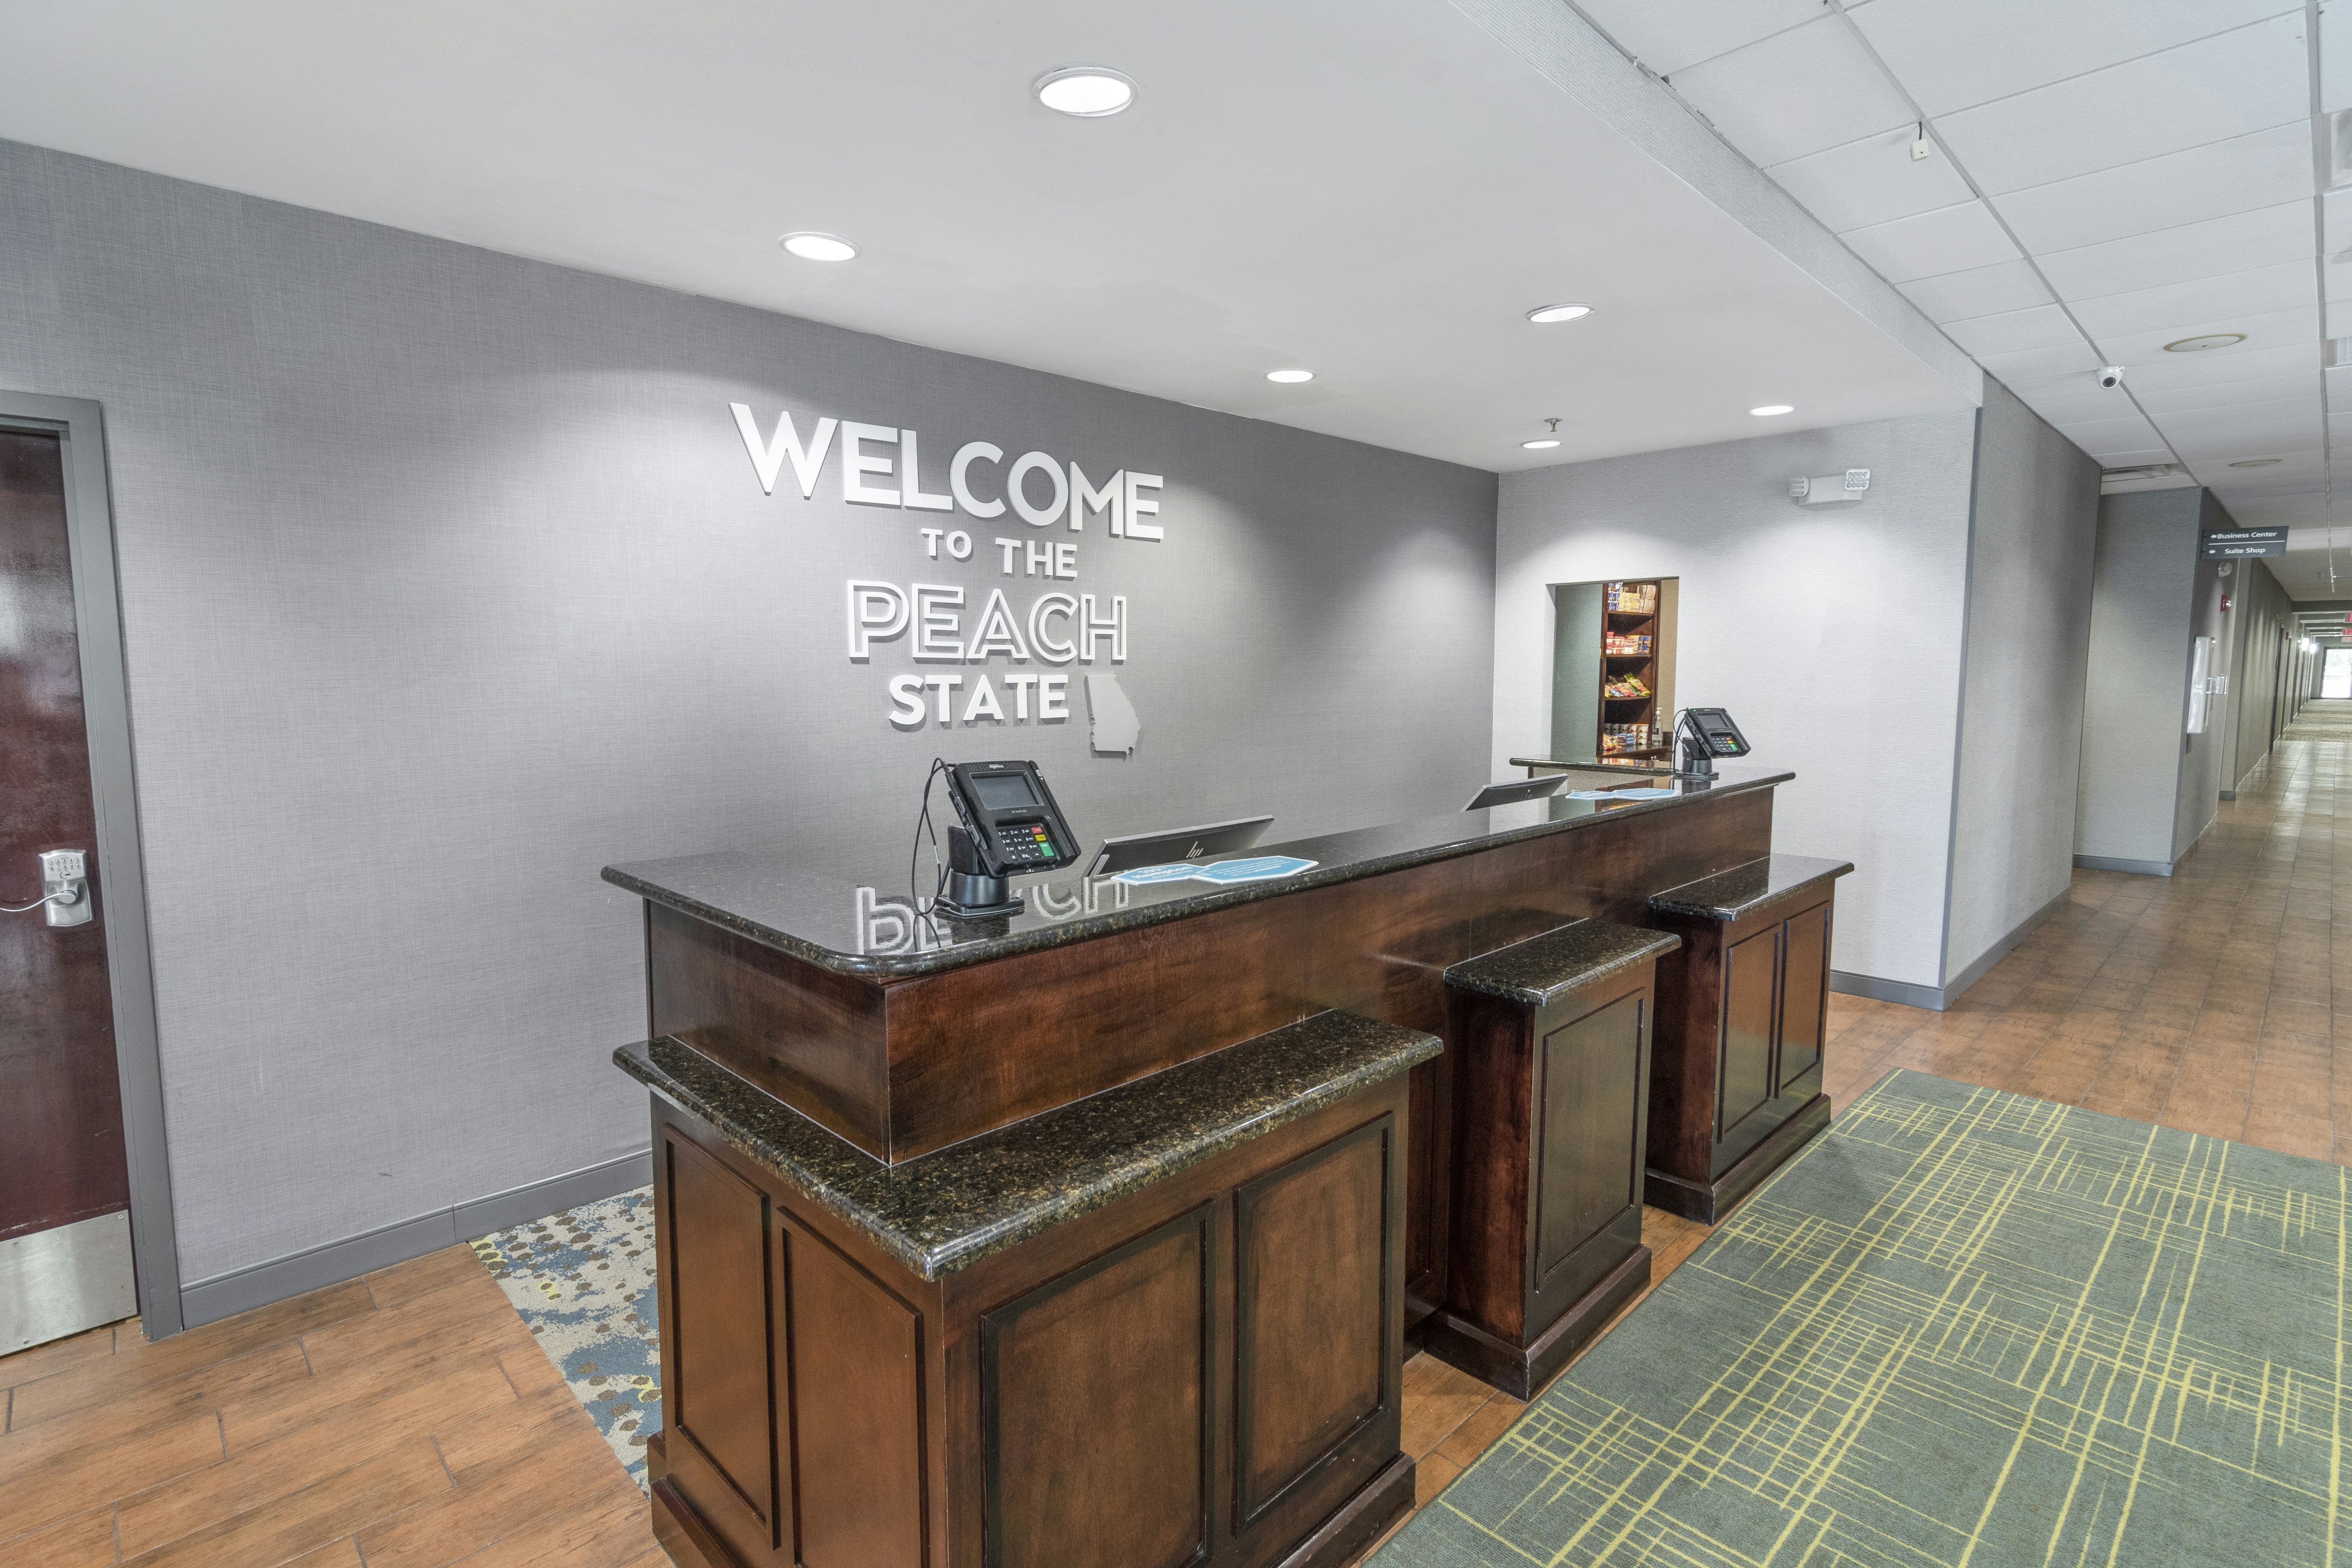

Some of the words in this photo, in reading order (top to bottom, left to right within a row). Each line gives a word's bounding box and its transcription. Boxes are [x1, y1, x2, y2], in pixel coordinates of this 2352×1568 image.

[728, 402, 1164, 540] WELCOME
[921, 528, 972, 558] TO
[996, 537, 1078, 577] THE
[847, 579, 1127, 662] PEACH
[889, 674, 1069, 726] STATE
[1131, 866, 1194, 879] Hampton
